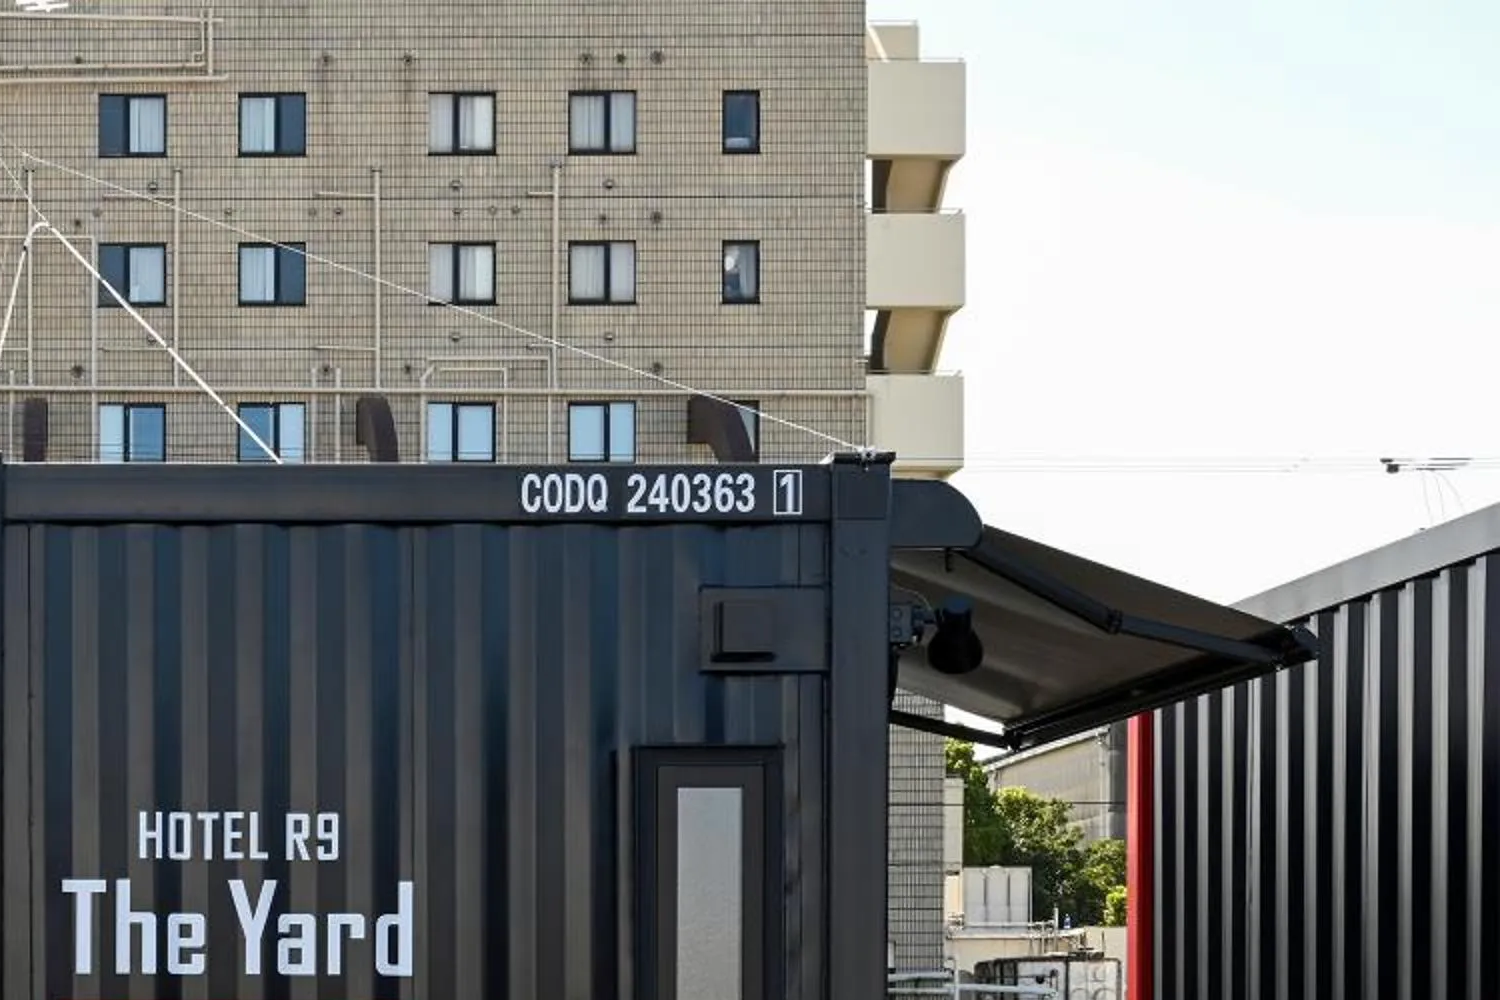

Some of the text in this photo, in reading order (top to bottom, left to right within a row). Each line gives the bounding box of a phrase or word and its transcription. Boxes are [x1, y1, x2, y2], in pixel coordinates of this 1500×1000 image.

[521, 472, 798, 514] CODQ 240363 1
[139, 811, 339, 861] HOTEL R9
[62, 879, 413, 976] The Yard
